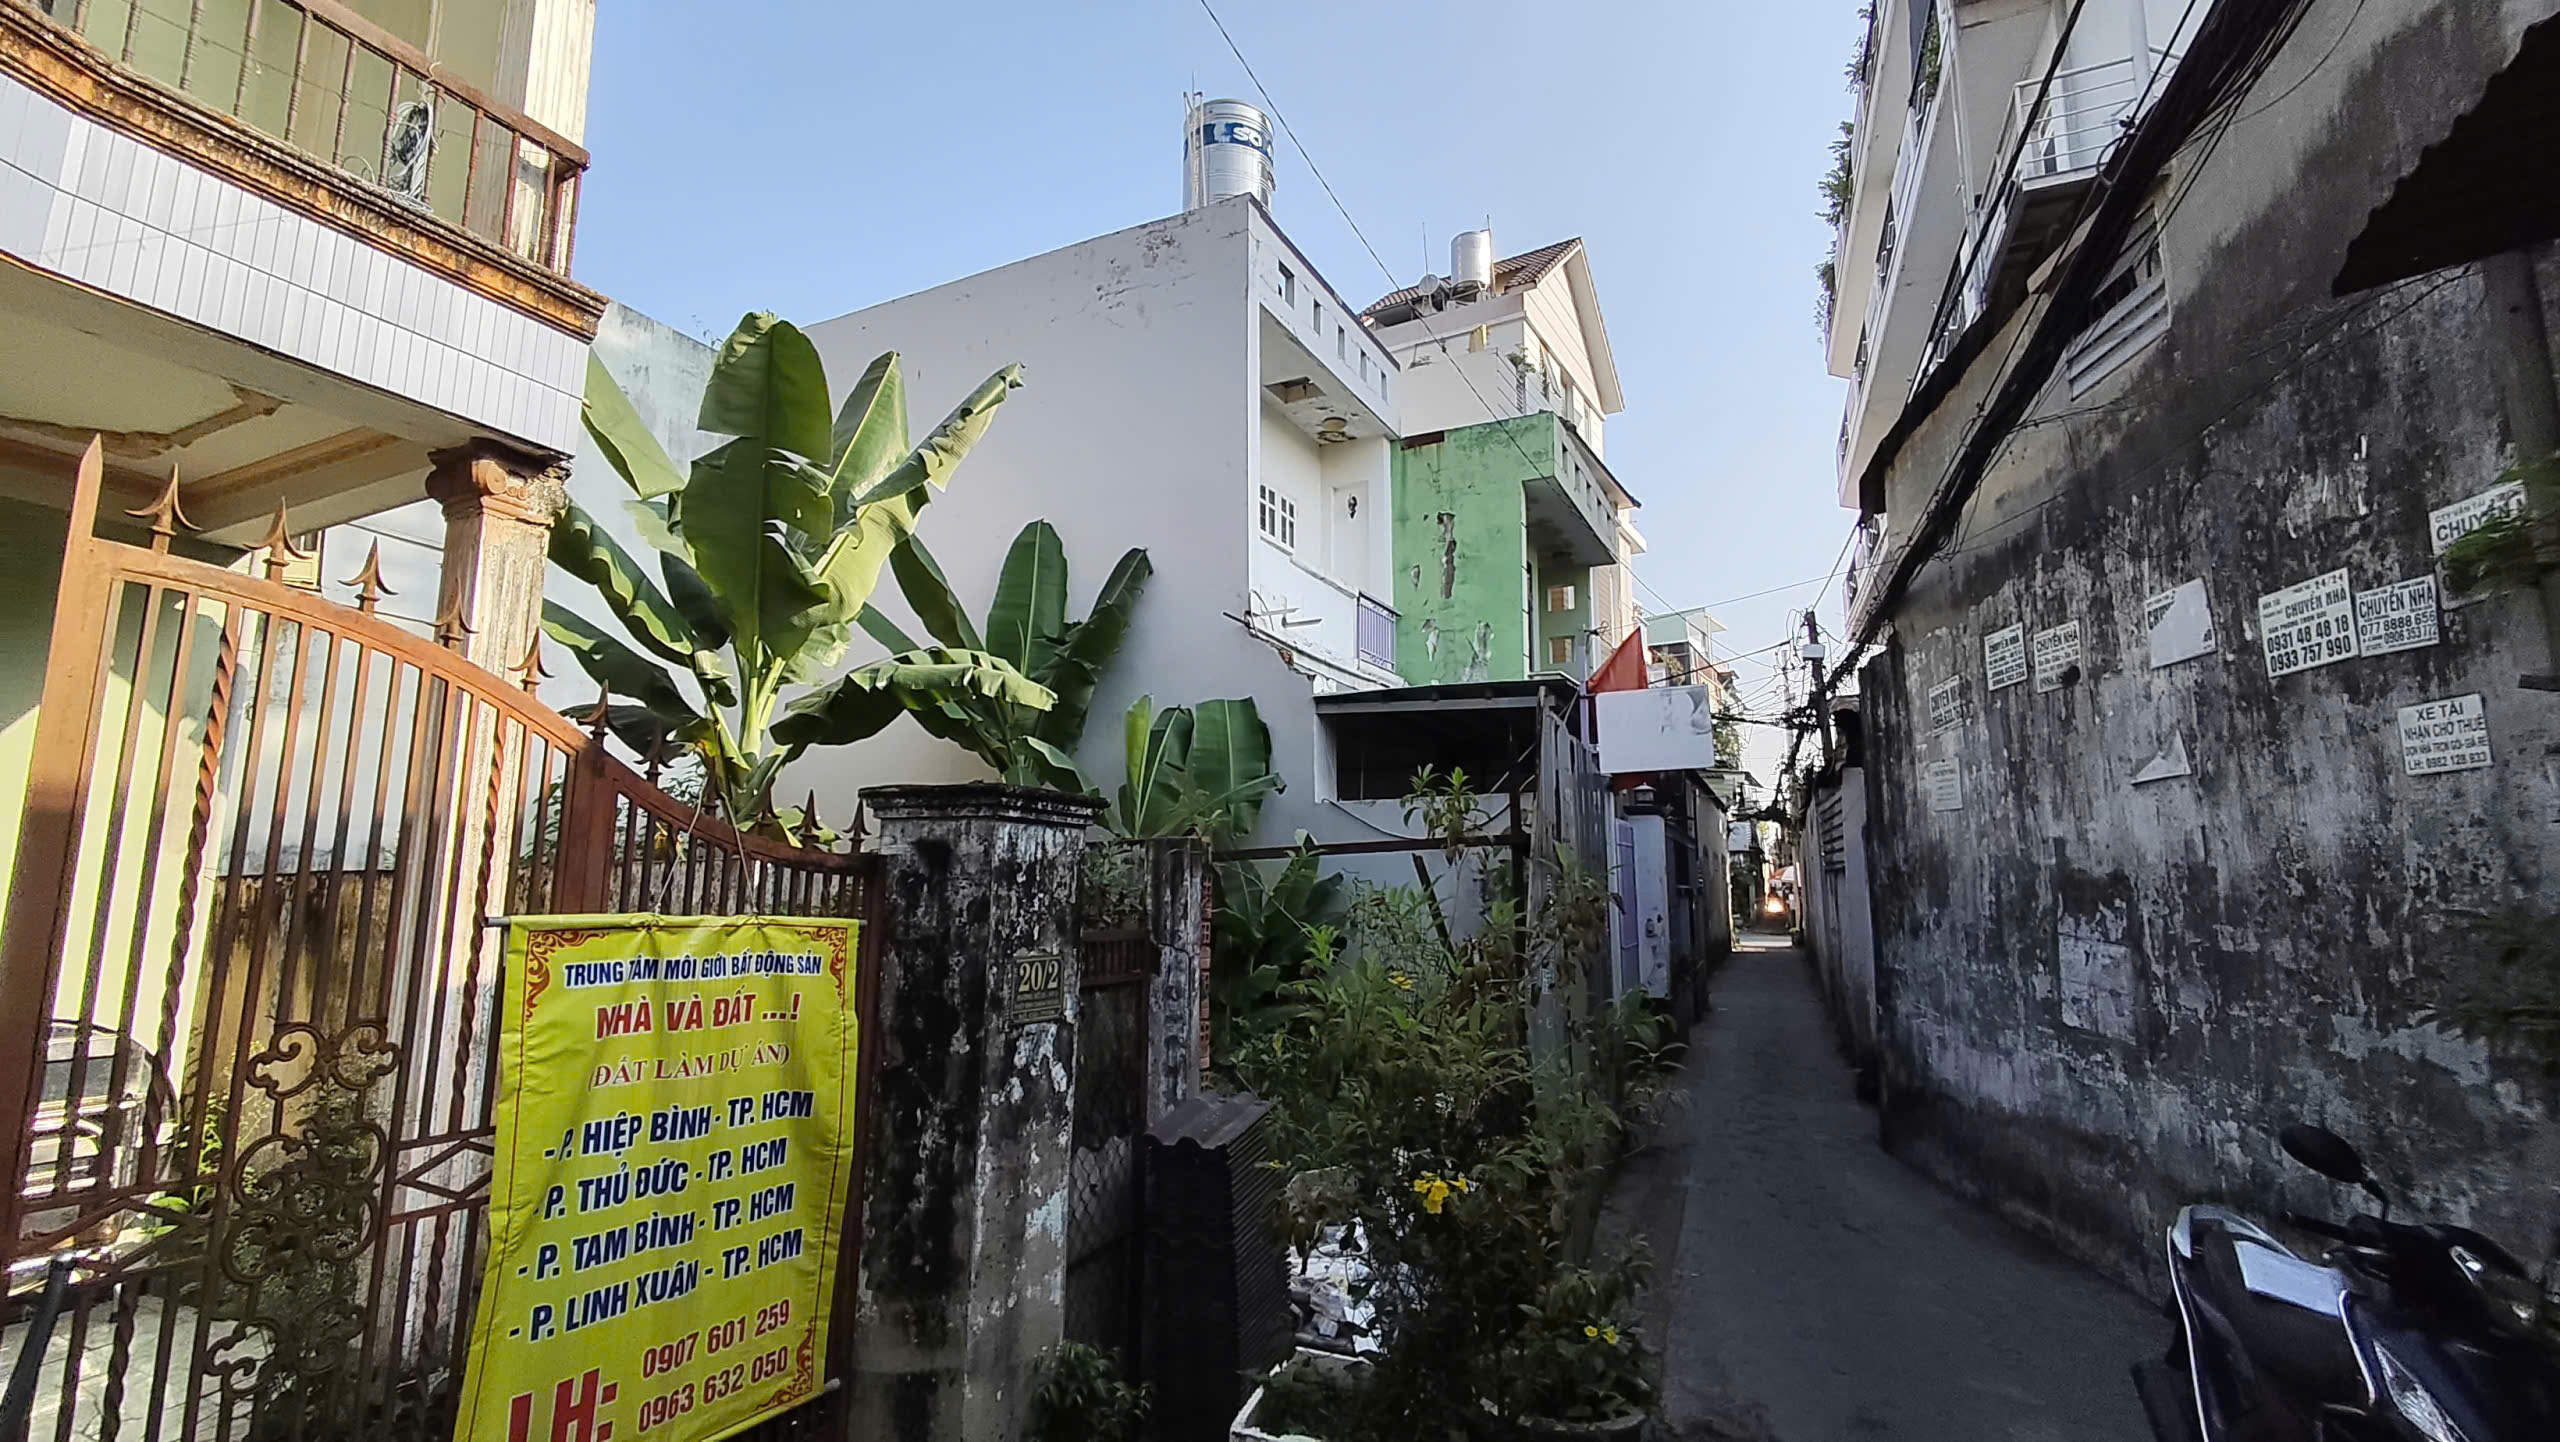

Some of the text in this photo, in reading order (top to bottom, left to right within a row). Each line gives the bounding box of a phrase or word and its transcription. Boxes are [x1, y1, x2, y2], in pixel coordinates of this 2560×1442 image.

[2284, 590, 2322, 619] CHUYỂN
[2325, 584, 2347, 606] NHÀ
[2359, 581, 2433, 618] CHUYỂN NHÀ
[2361, 621, 2381, 636] 077
[2383, 614, 2412, 632] 8888
[2414, 609, 2436, 626] 656
[2267, 631, 2293, 653] 0931
[2297, 625, 2312, 644] 48
[2316, 619, 2332, 639] 48
[2335, 614, 2349, 634] 18
[2270, 649, 2299, 673] 0933
[2301, 641, 2322, 664] 757
[2326, 634, 2351, 658] 990
[2416, 700, 2464, 721] XE TẢI
[564, 948, 822, 988] TRUNG TÂM MÔI GIỚI BẤT ĐỘNG SẢN
[1018, 960, 1060, 993] 20/2
[595, 995, 653, 1041] NHÀ
[665, 993, 704, 1032] VÀ
[711, 984, 757, 1028] ĐẤT
[588, 1040, 791, 1092] (ĐẤT LÀM DỰ ÁN)
[581, 1110, 644, 1159] HIỆP
[649, 1104, 713, 1143] BÌNH
[727, 1096, 755, 1128] TP.
[761, 1089, 815, 1122] HCM
[543, 1185, 566, 1221] P.
[577, 1161, 631, 1213] THỦ
[635, 1157, 690, 1200] ĐỨC
[707, 1150, 734, 1183] TP.
[741, 1136, 788, 1176] HCM
[536, 1243, 561, 1281] P.
[572, 1226, 629, 1273] TAM
[633, 1210, 697, 1255] BÌNH
[712, 1198, 742, 1231] TP.
[749, 1182, 796, 1222] HCM
[530, 1304, 556, 1342] P.
[564, 1281, 629, 1332] LINH
[634, 1259, 699, 1310] XUÂN
[721, 1245, 752, 1280] TP.
[757, 1227, 804, 1270] HCM
[641, 1298, 791, 1380] 0907 601 259
[637, 1382, 696, 1433] 0963
[703, 1363, 746, 1405] 632
[750, 1344, 789, 1385] 050
